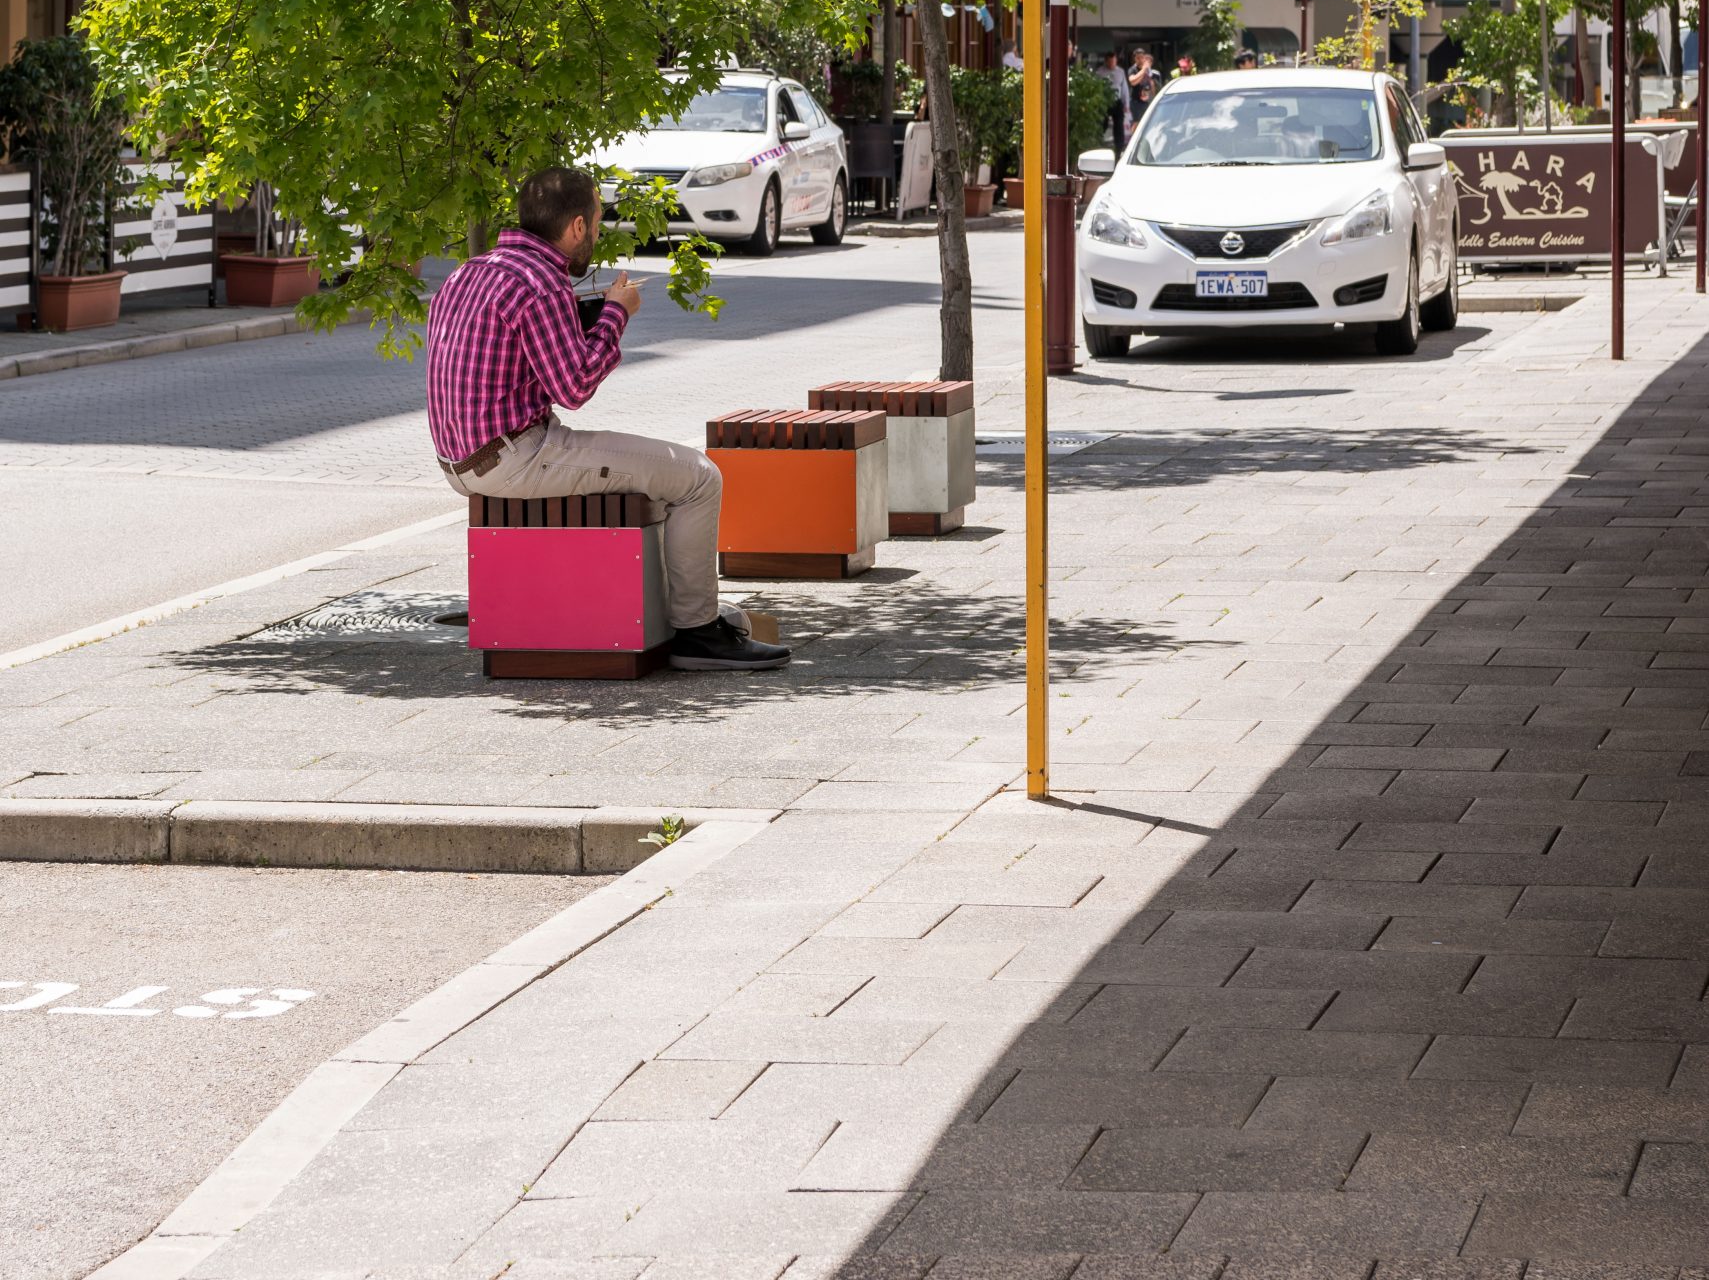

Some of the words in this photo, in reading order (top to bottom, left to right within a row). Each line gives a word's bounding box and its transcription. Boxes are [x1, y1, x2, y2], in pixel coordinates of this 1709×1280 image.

[1447, 150, 1596, 194] AHARA
[1457, 234, 1484, 248] ddle
[1488, 231, 1536, 248] Eastern
[1539, 230, 1585, 249] Cuisine
